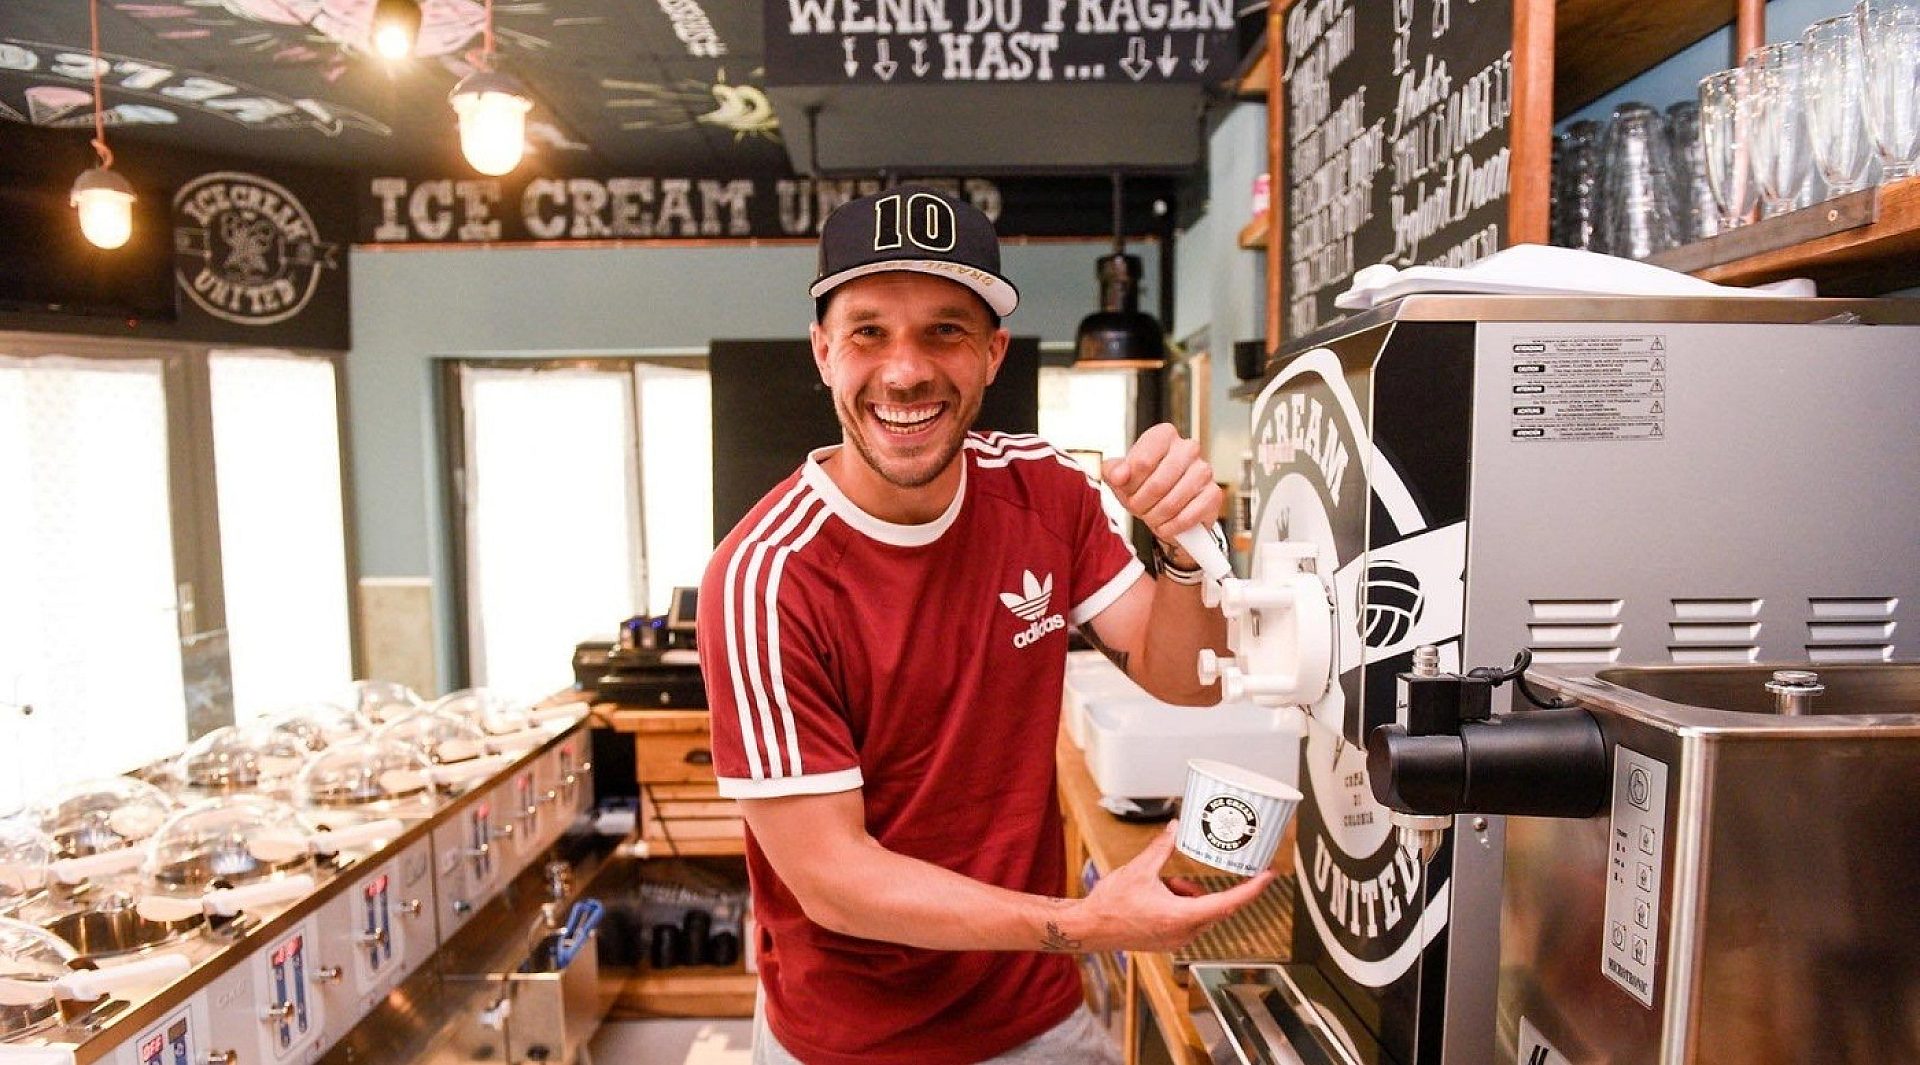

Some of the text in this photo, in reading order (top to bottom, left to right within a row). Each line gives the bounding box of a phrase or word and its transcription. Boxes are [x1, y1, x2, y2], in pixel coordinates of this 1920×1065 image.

[788, 0, 1236, 33] WENN DU FRAGEN
[940, 33, 1105, 80] HAST...
[184, 184, 310, 242] ICE CREAM
[371, 178, 1001, 241] ICE CREAM UND
[873, 193, 956, 252] 10
[194, 268, 295, 314] UNITED
[1013, 614, 1065, 649] adidas
[1313, 833, 1421, 938] UNITED
